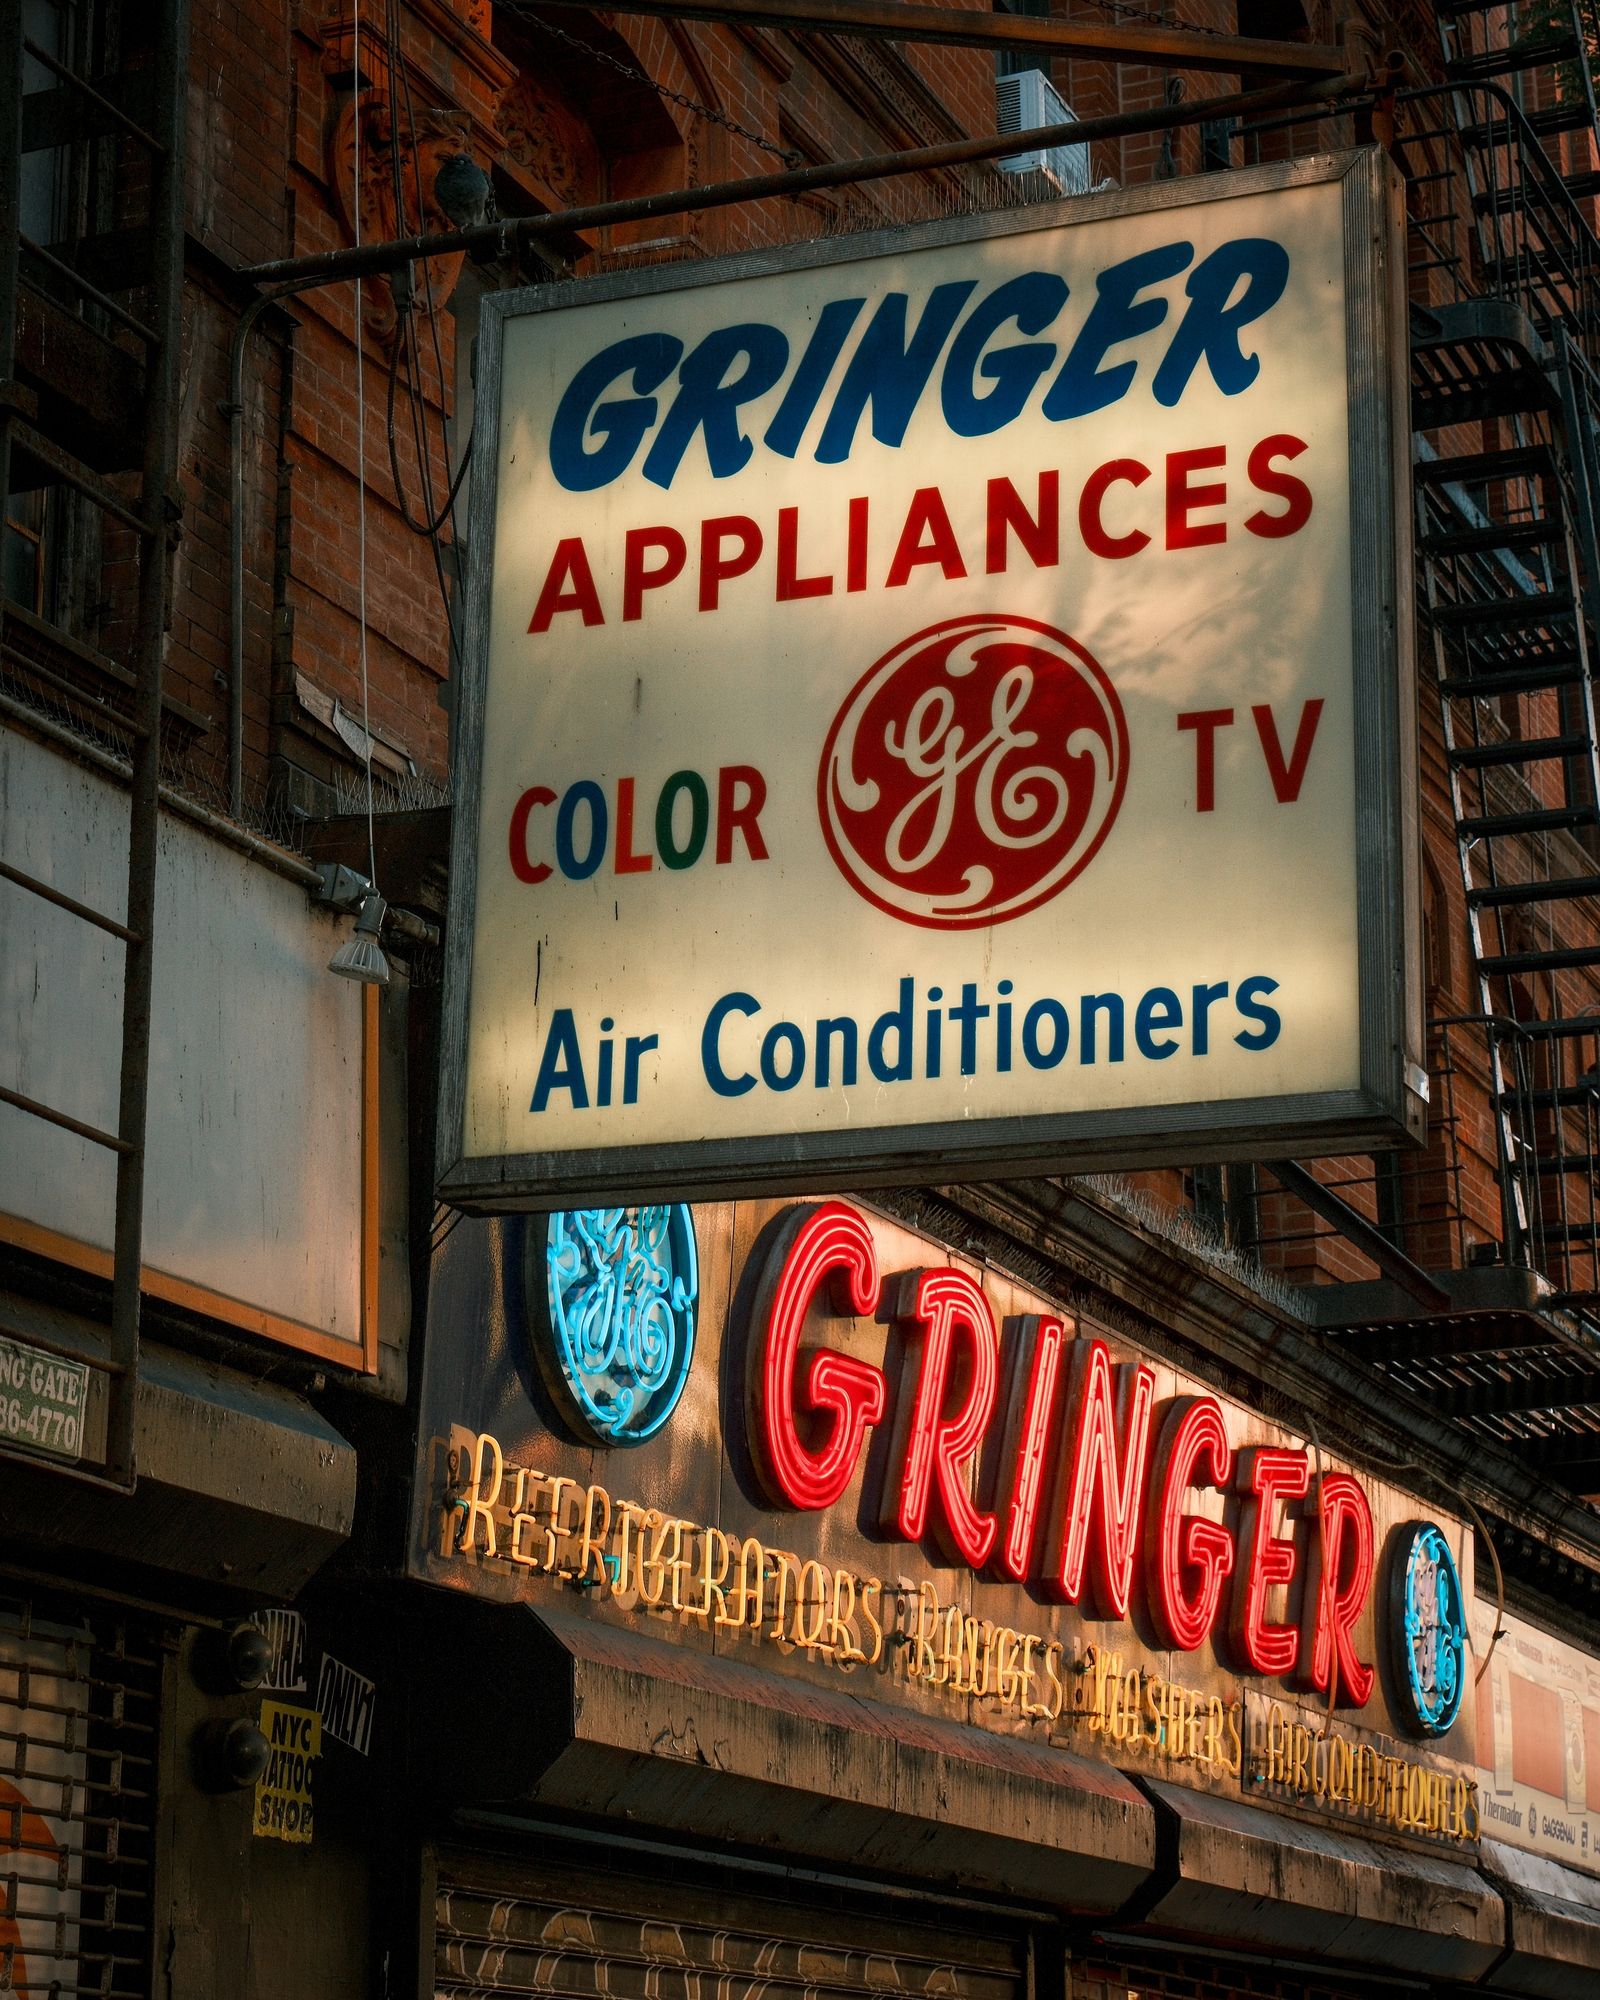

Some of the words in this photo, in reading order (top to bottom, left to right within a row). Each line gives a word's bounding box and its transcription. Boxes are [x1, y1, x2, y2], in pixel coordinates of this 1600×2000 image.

[549, 238, 1290, 492] GRINGER
[527, 433, 1314, 634] APPLIANCES
[508, 764, 770, 885] COLOR
[1176, 698, 1326, 813] TV
[528, 1008, 660, 1112] Air
[700, 975, 1283, 1098] Conditioners
[30, 1361, 80, 1405] GATE
[762, 1200, 1375, 1709] GRINGER
[453, 1432, 882, 1666] REFRIGERATORS
[908, 1580, 1063, 1720] RANGES
[1086, 1640, 1242, 1778] WASHERS
[271, 1711, 313, 1752] NYC
[1265, 1702, 1311, 1793] AIR
[1311, 1728, 1481, 1842] CONDITIONERS
[258, 1794, 313, 1834] SHOP
[1483, 1790, 1523, 1828] Thermador
[1542, 1814, 1576, 1846] GAGGENAU
